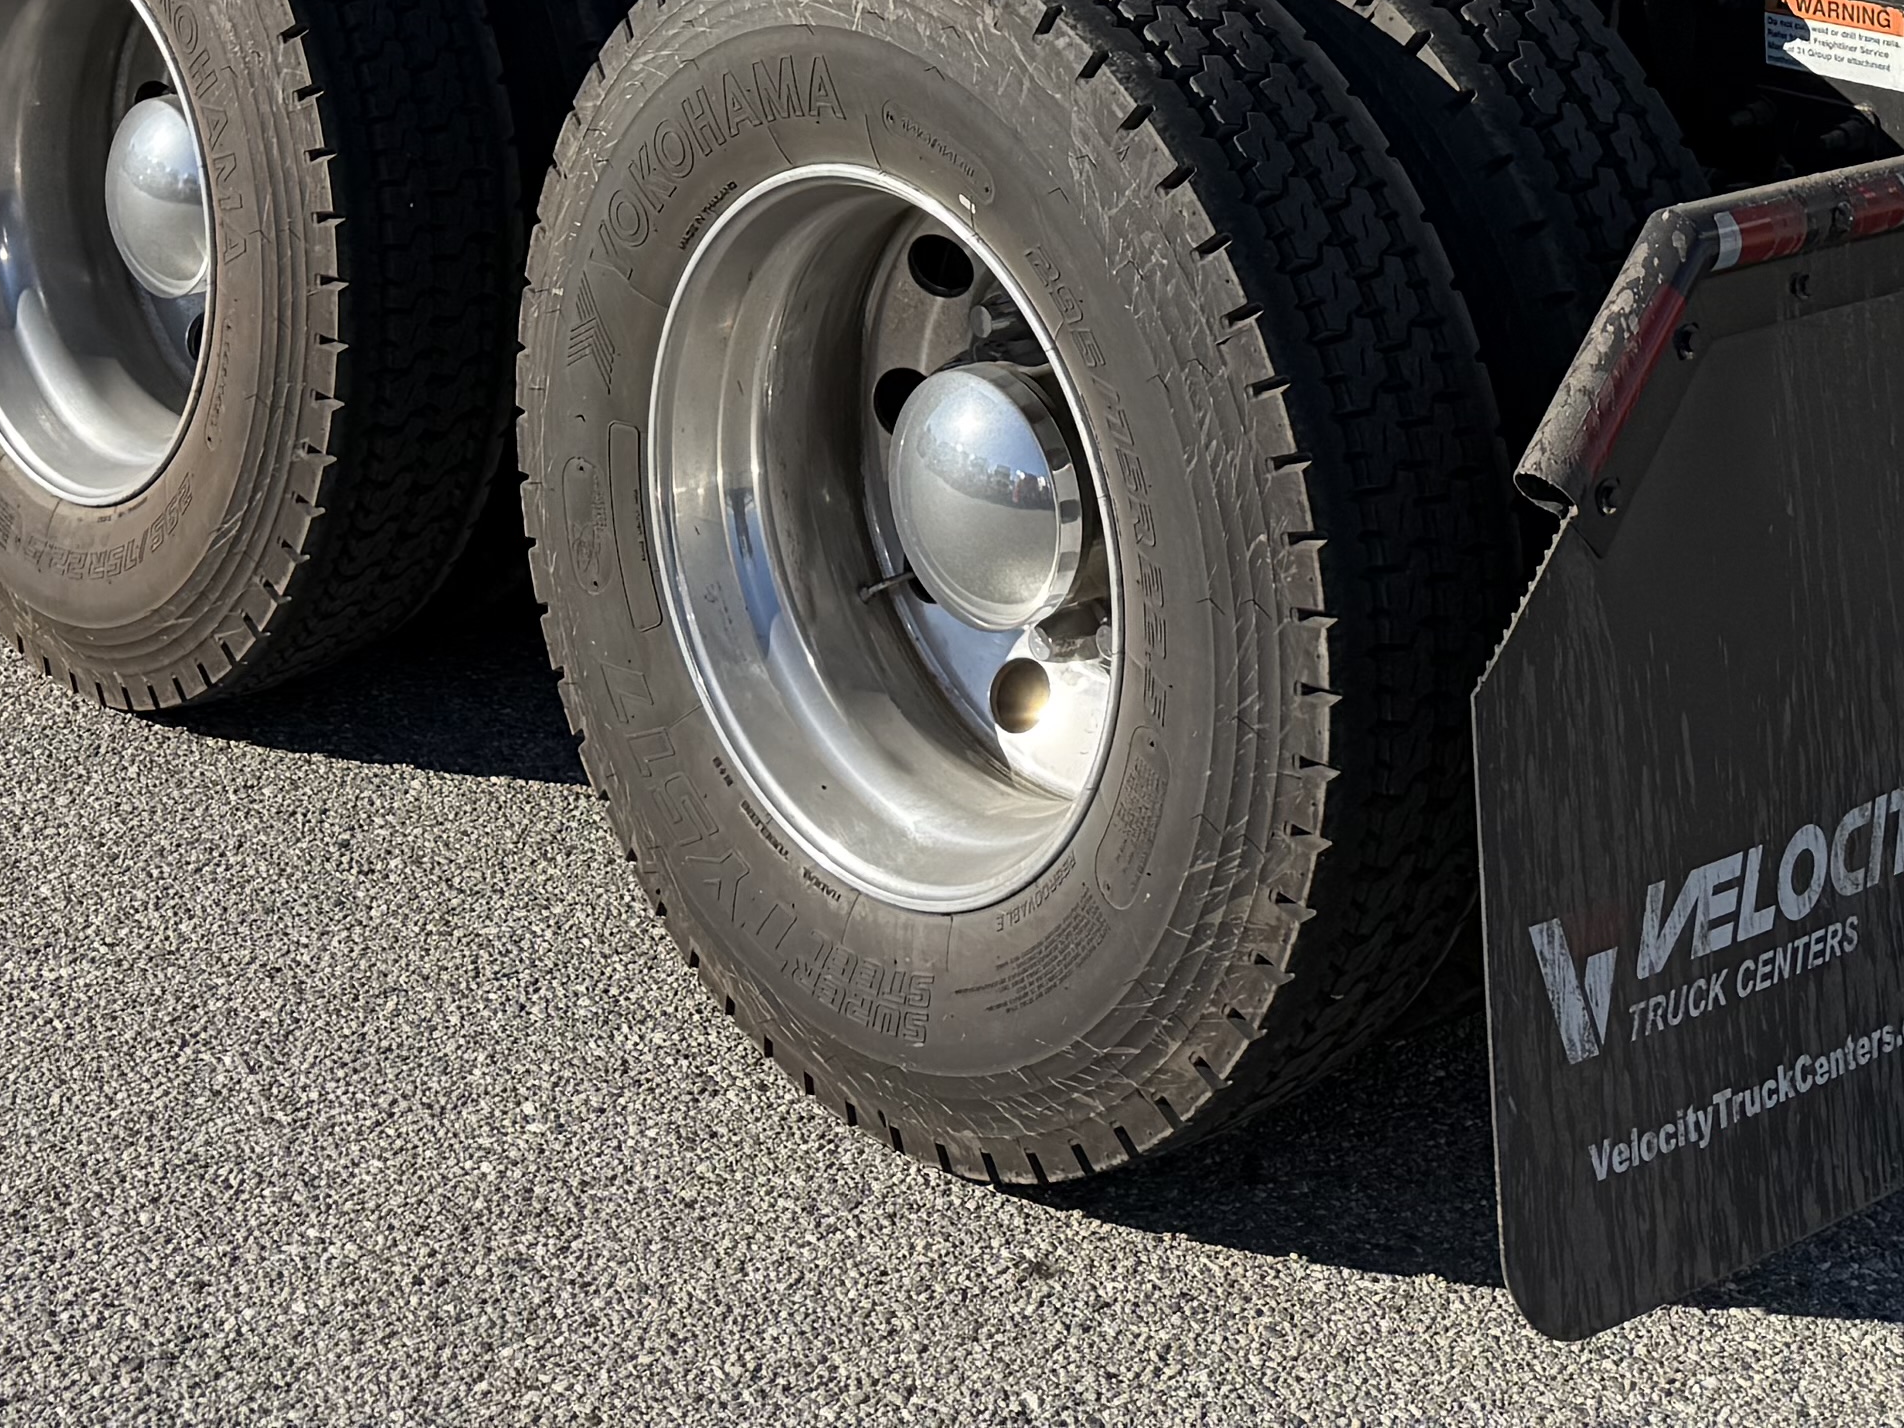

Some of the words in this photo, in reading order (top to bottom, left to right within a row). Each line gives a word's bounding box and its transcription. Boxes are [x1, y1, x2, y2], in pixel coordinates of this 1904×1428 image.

[1807, 49, 1833, 62] Group
[1813, 37, 1858, 53] Freightliner
[1859, 46, 1890, 59] Service
[1830, 29, 1839, 37] or
[585, 54, 848, 283] YOKOHAMA
[996, 849, 1077, 933] REGROOVABLE
[1628, 966, 1729, 1043] TRUCK
[1736, 915, 1859, 1000] CENTERS
